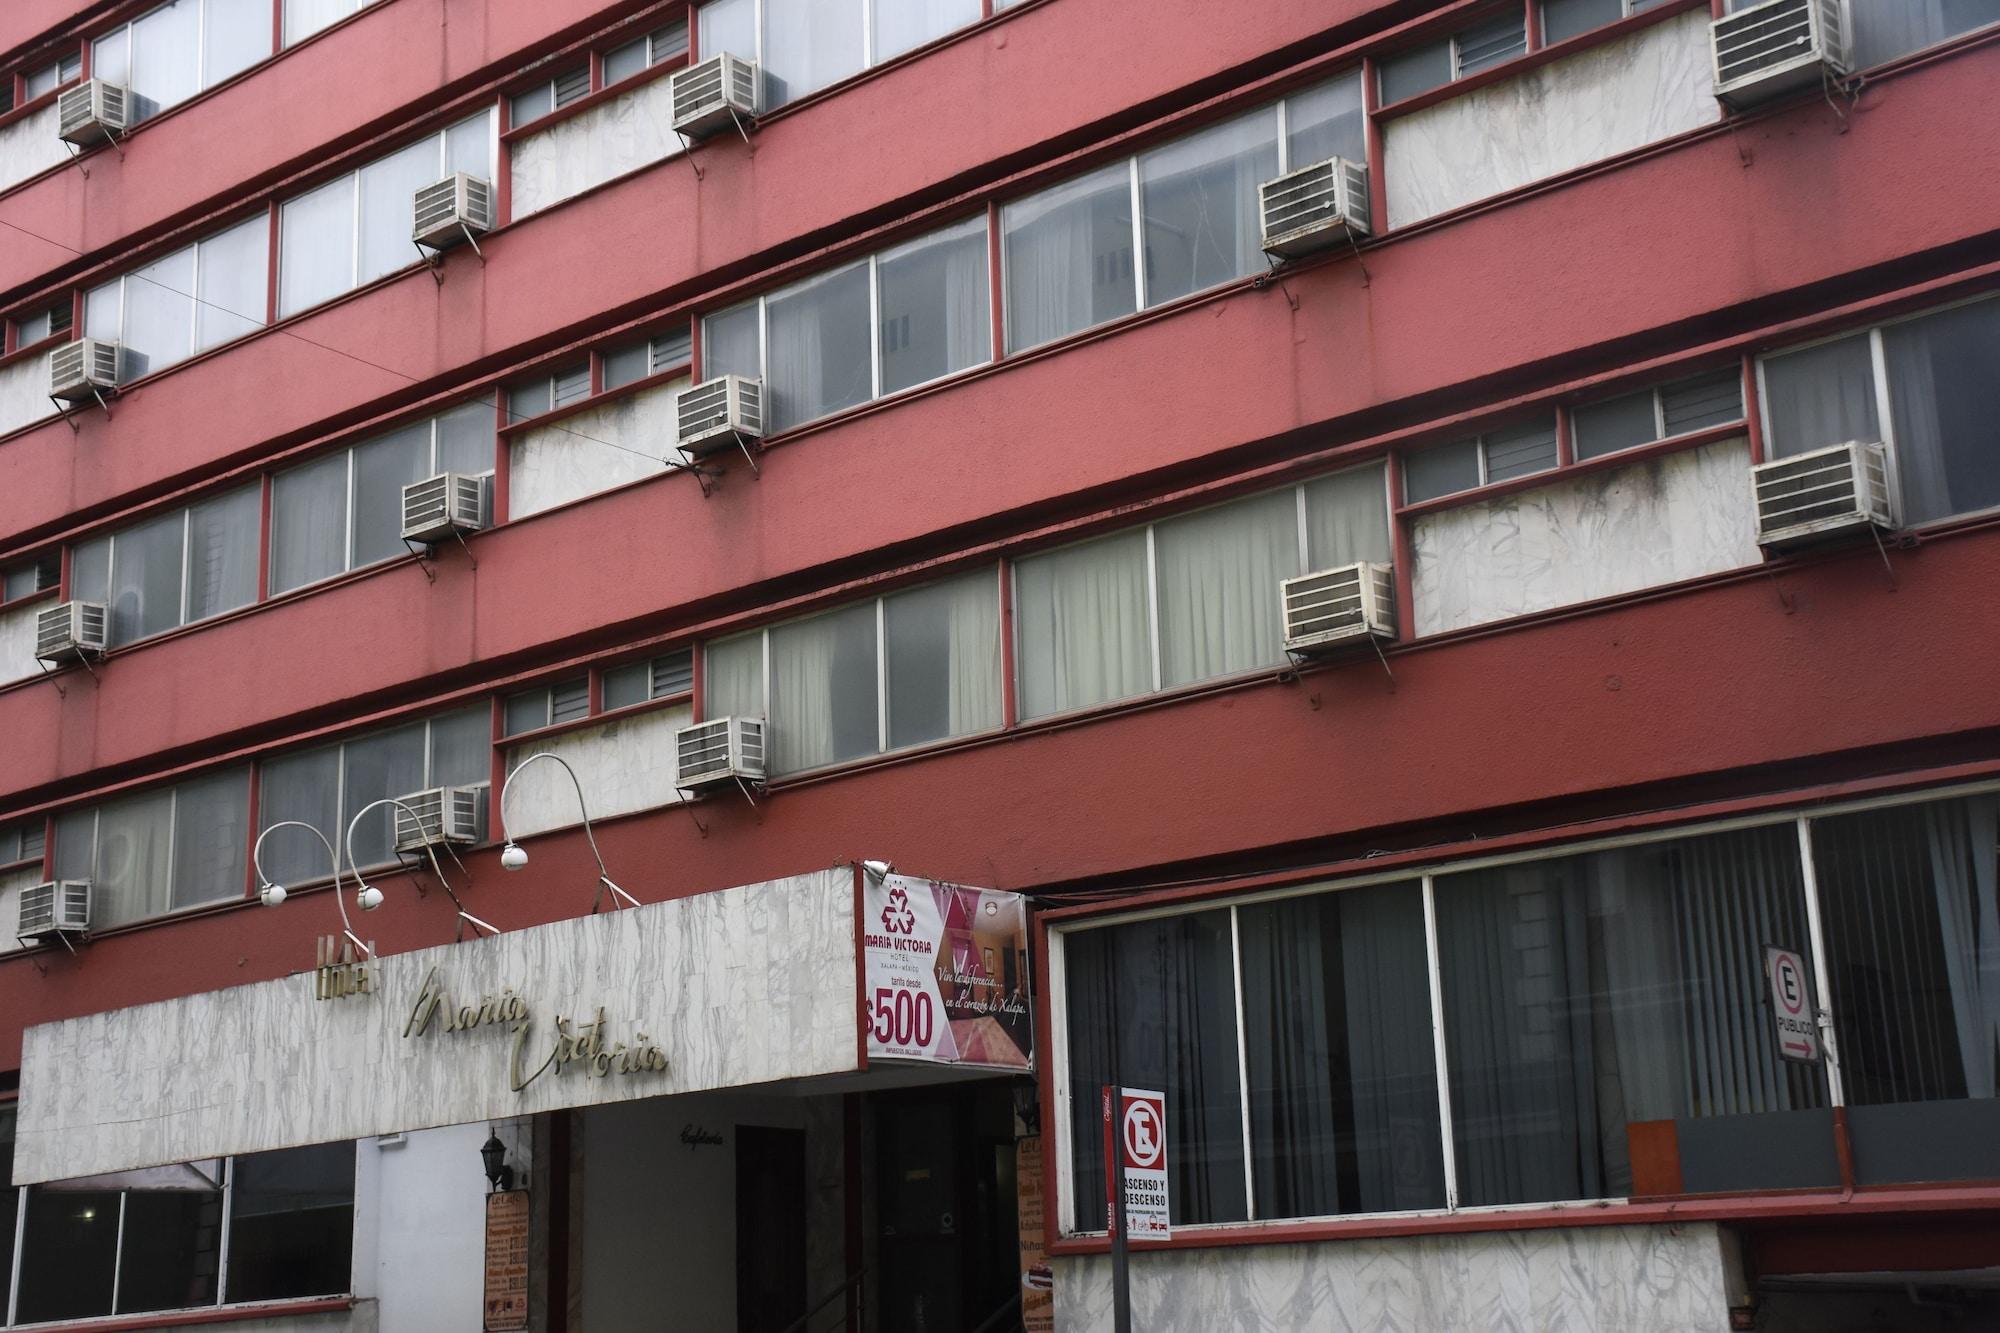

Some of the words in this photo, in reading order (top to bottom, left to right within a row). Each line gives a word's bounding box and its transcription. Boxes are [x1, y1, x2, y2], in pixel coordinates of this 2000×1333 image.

[865, 934, 892, 949] MARIA
[894, 937, 932, 954] VICTORIA
[890, 953, 909, 962] HOTEL
[316, 935, 376, 1001] Hotel
[891, 976, 905, 987] tarifa
[906, 977, 921, 989] desde
[1782, 966, 1797, 1001] E
[402, 966, 528, 1038] Maria
[511, 1005, 669, 1091] Victoria
[1125, 1178, 1158, 1191] ASCENSO
[1160, 1180, 1165, 1191] Y
[1125, 1193, 1166, 1206] DESCENSO
